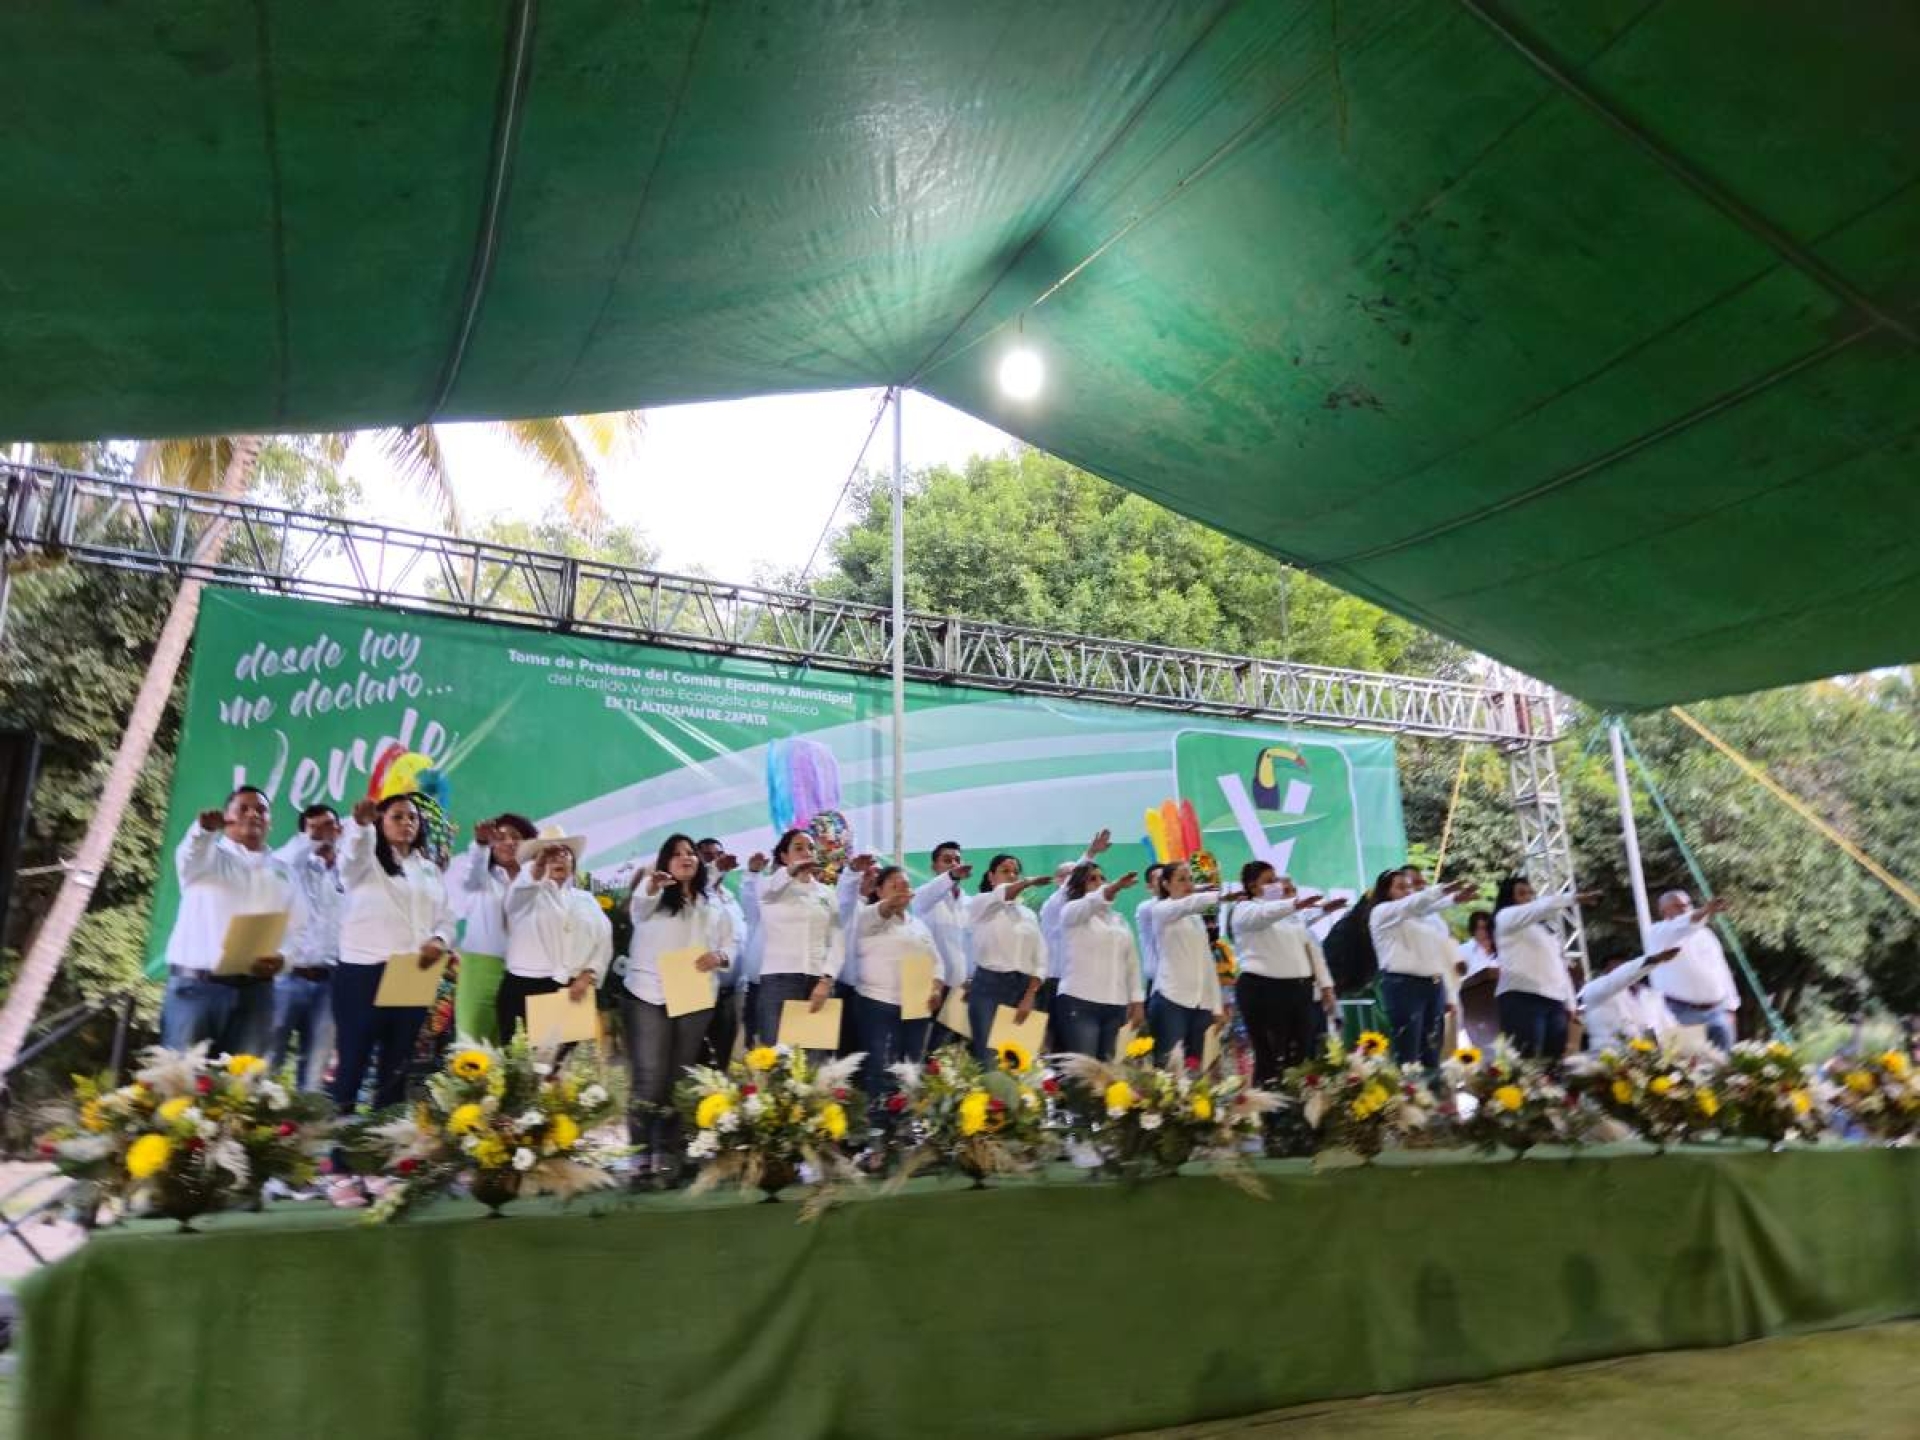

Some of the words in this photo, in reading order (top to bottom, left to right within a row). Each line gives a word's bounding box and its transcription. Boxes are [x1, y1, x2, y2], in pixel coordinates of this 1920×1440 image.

[235, 634, 344, 683] desde
[359, 627, 421, 670] hoy
[508, 649, 550, 666] Toma
[554, 655, 574, 669] de
[579, 659, 641, 677] Protesta
[645, 669, 667, 682] del
[726, 678, 786, 696] Ejecutivo
[788, 687, 854, 705] Municipal
[548, 673, 572, 686] del
[576, 674, 627, 693] Partido
[632, 682, 675, 699] Verde
[677, 688, 748, 708] Ecologista
[751, 698, 769, 711] de
[772, 699, 819, 716] México
[219, 695, 273, 729] me
[605, 696, 622, 709] EN
[706, 708, 722, 721] DE
[723, 709, 769, 727] ZAPATA
